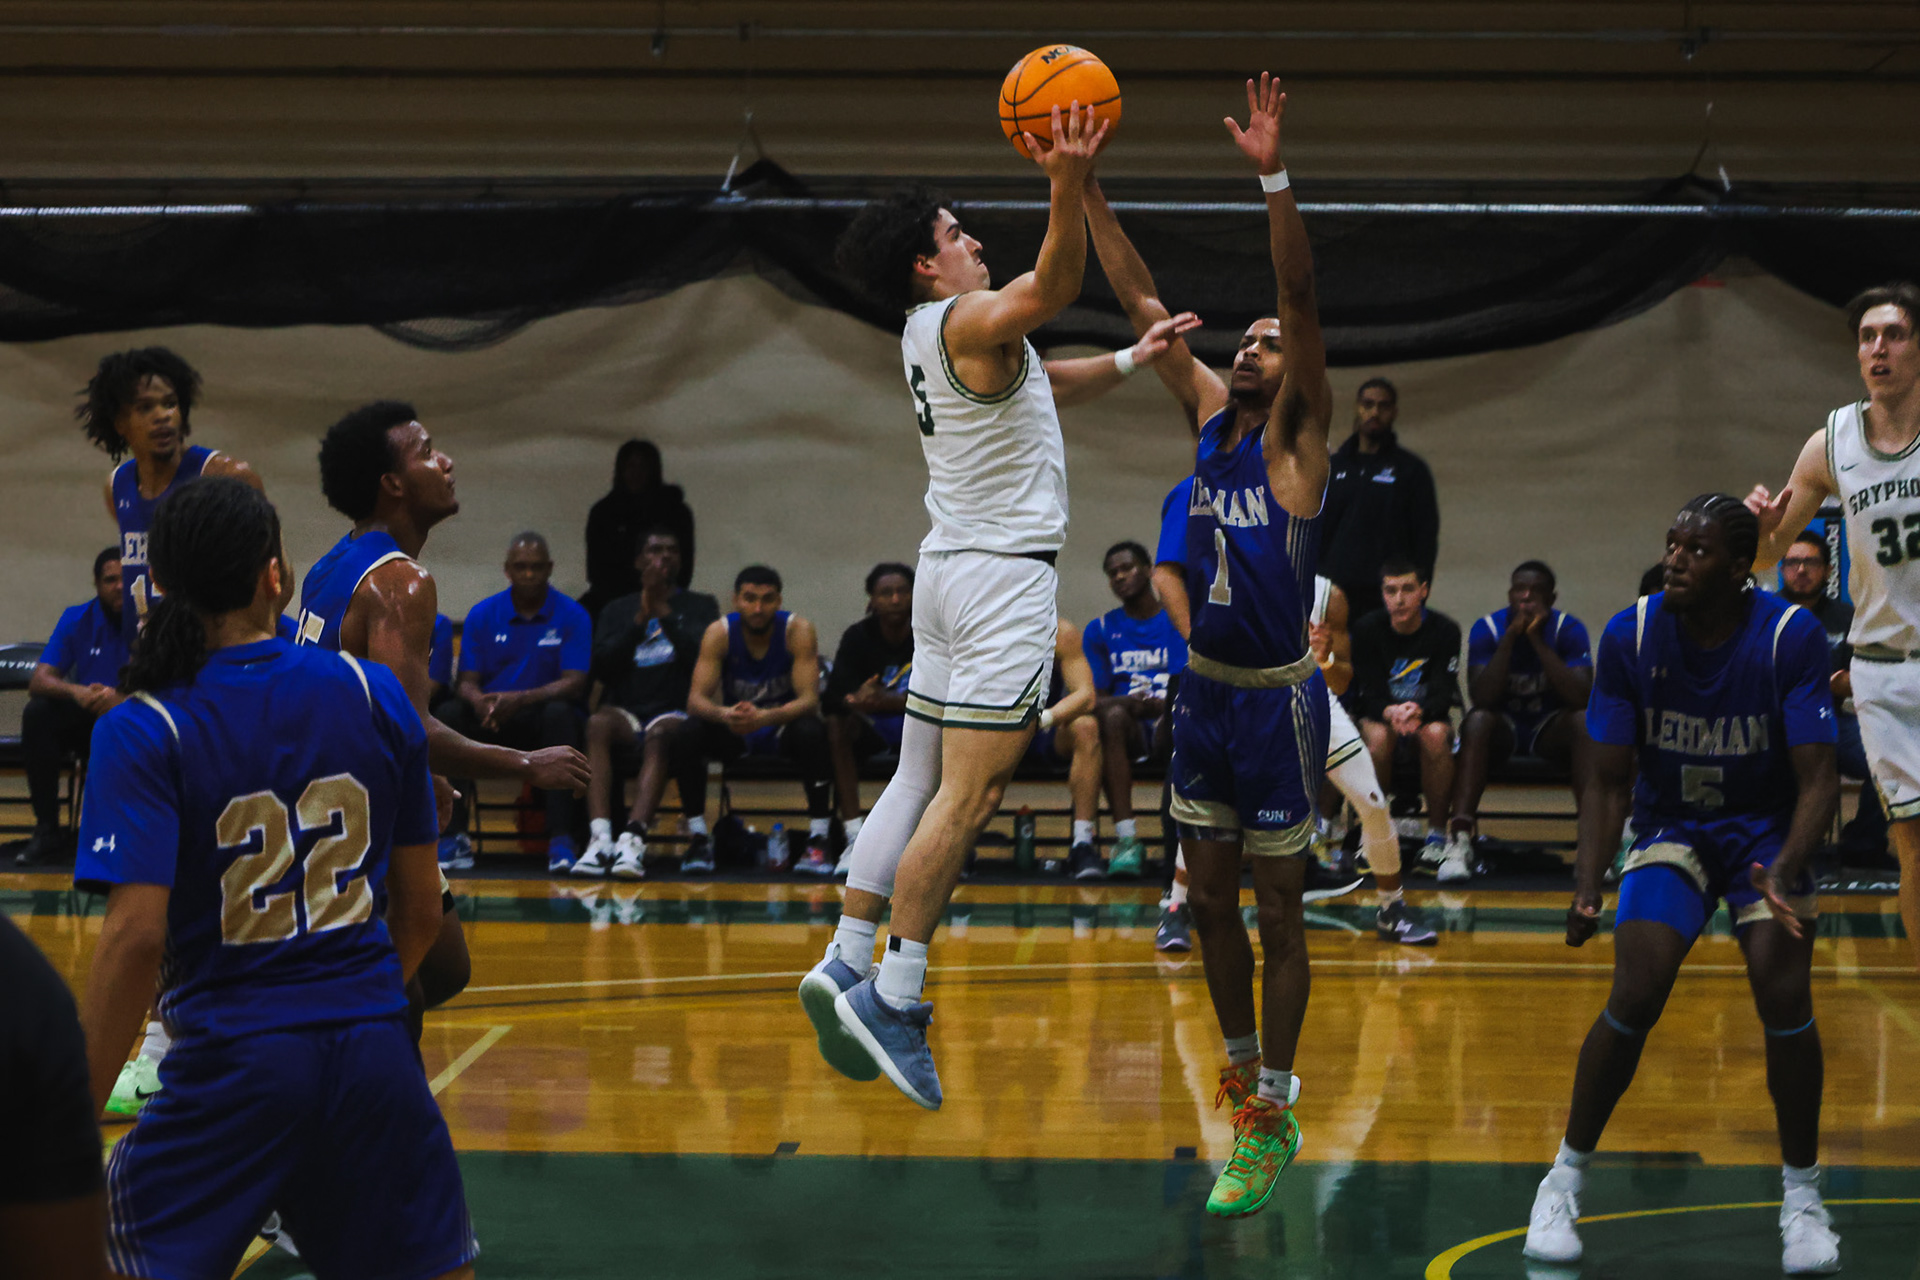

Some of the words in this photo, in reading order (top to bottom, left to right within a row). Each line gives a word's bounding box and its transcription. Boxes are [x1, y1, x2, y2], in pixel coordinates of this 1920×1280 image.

[910, 364, 935, 436] 5
[1208, 528, 1232, 606] 1
[1644, 707, 1769, 756] LEHMAN
[1257, 809, 1292, 823] CUNY
[1681, 763, 1725, 811] 5
[216, 772, 374, 946] 22
